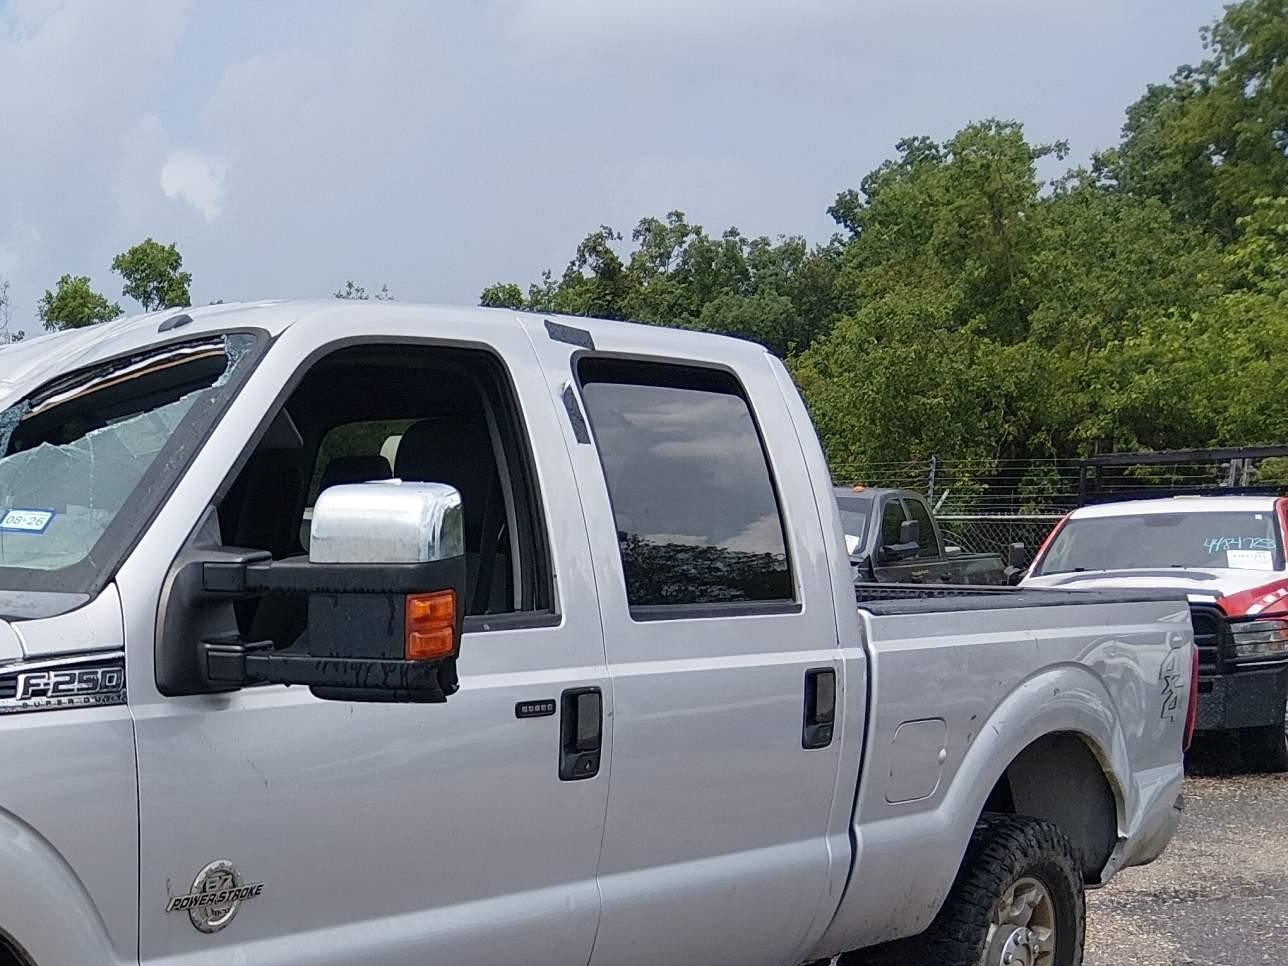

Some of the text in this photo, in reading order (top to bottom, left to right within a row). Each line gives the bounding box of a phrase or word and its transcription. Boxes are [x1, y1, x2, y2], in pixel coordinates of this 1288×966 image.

[15, 668, 124, 701] F-250
[22, 698, 74, 709] SUPER
[217, 883, 264, 905] STROKE
